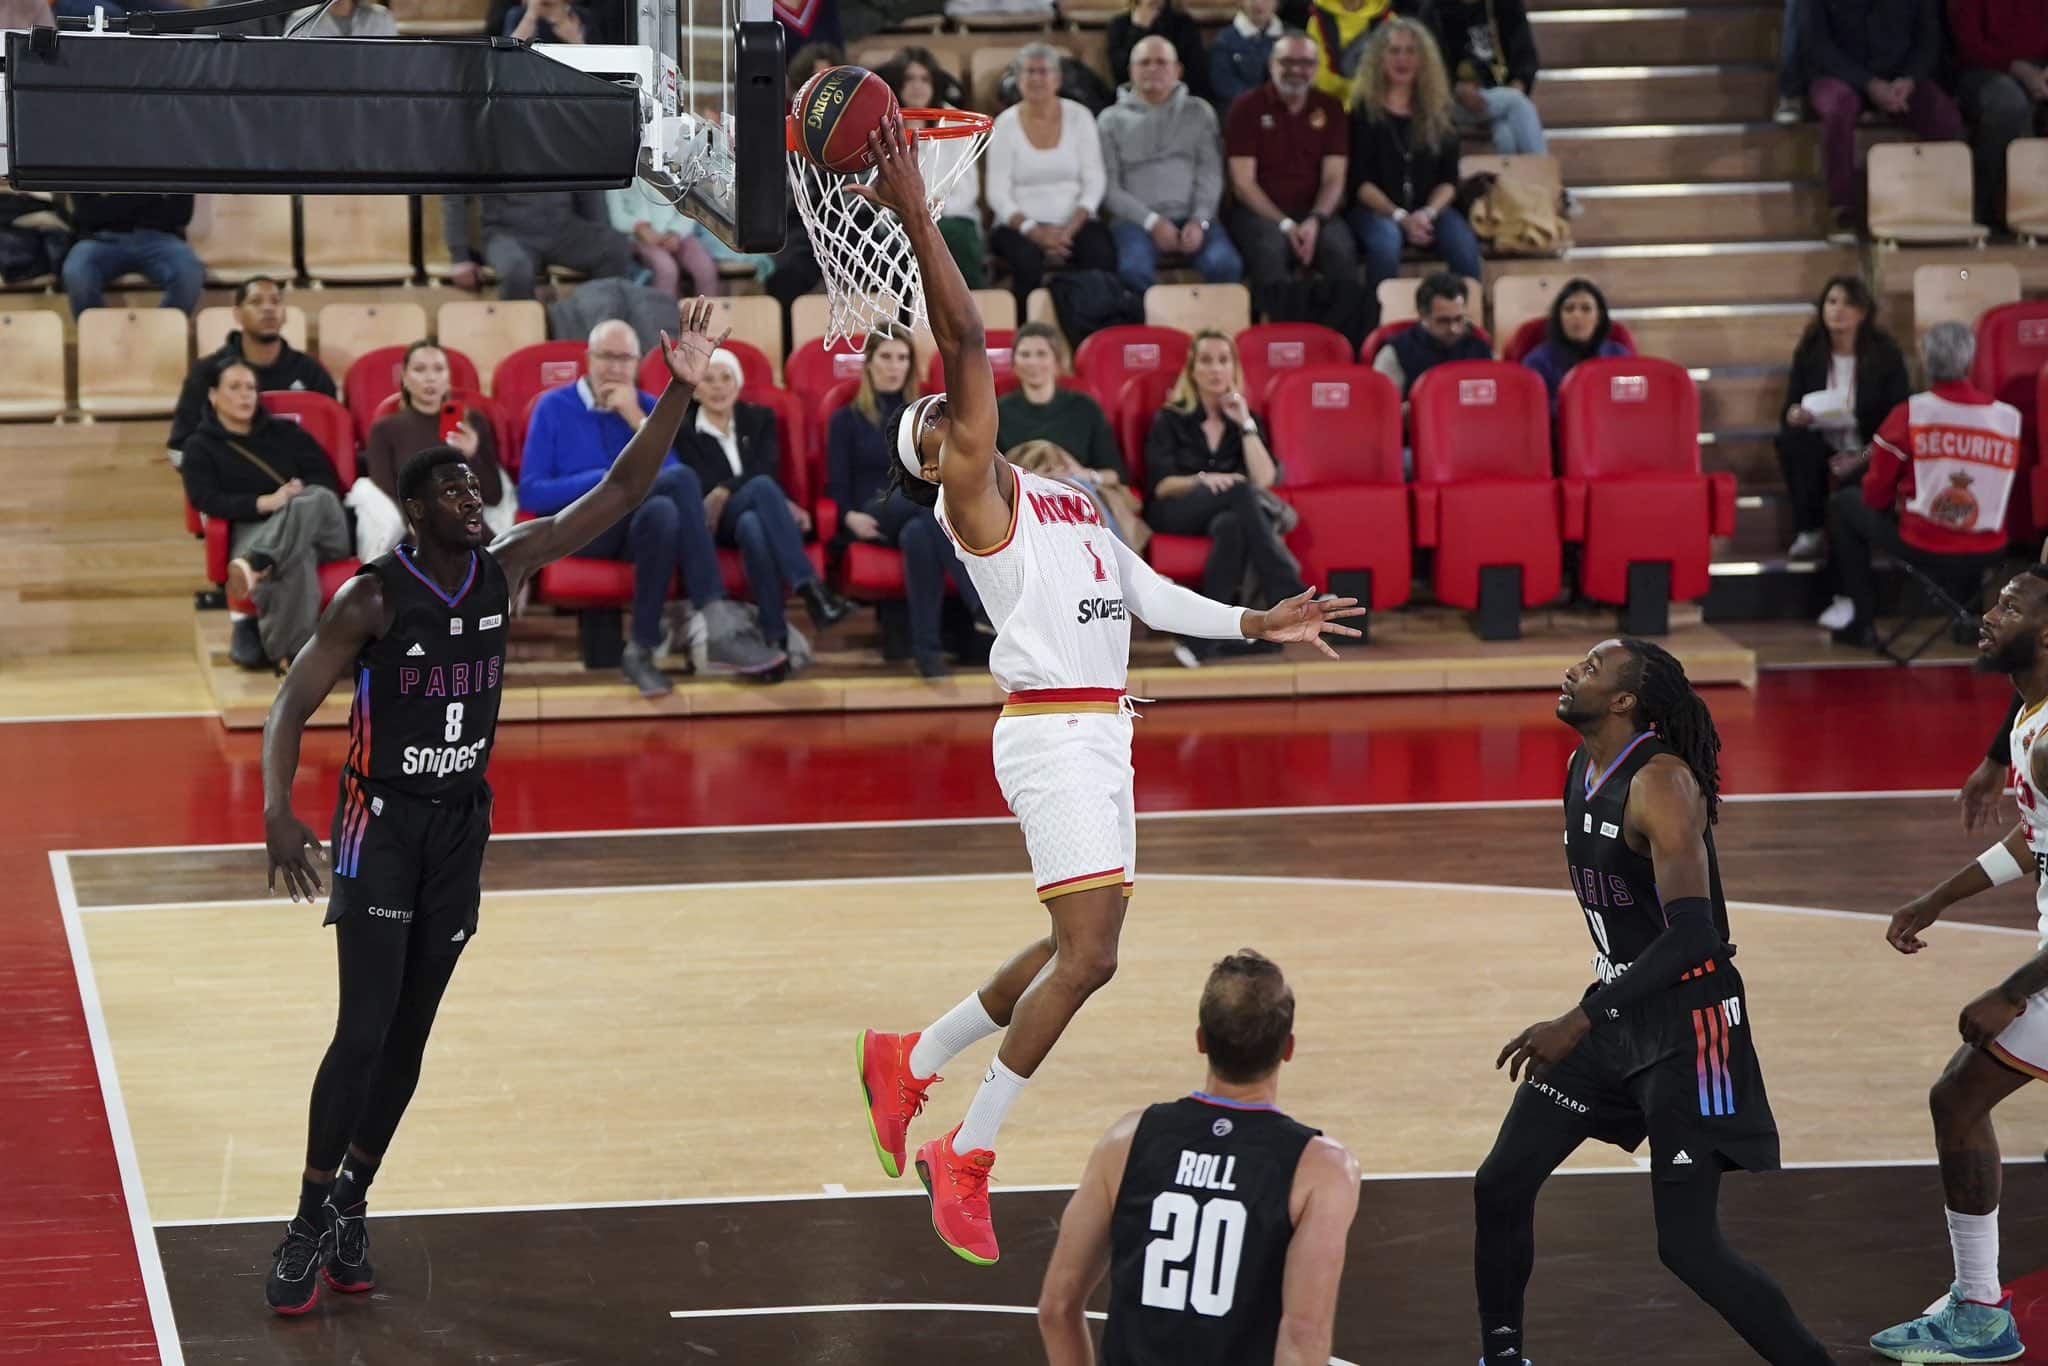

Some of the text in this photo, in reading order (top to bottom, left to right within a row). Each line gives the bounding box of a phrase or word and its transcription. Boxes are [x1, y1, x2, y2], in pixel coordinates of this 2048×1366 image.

[1082, 540, 1108, 582] 1
[399, 655, 500, 697] PARIS
[444, 702, 464, 742] 8
[1174, 1149, 1236, 1191] ROLL
[1141, 1191, 1248, 1317] 20
